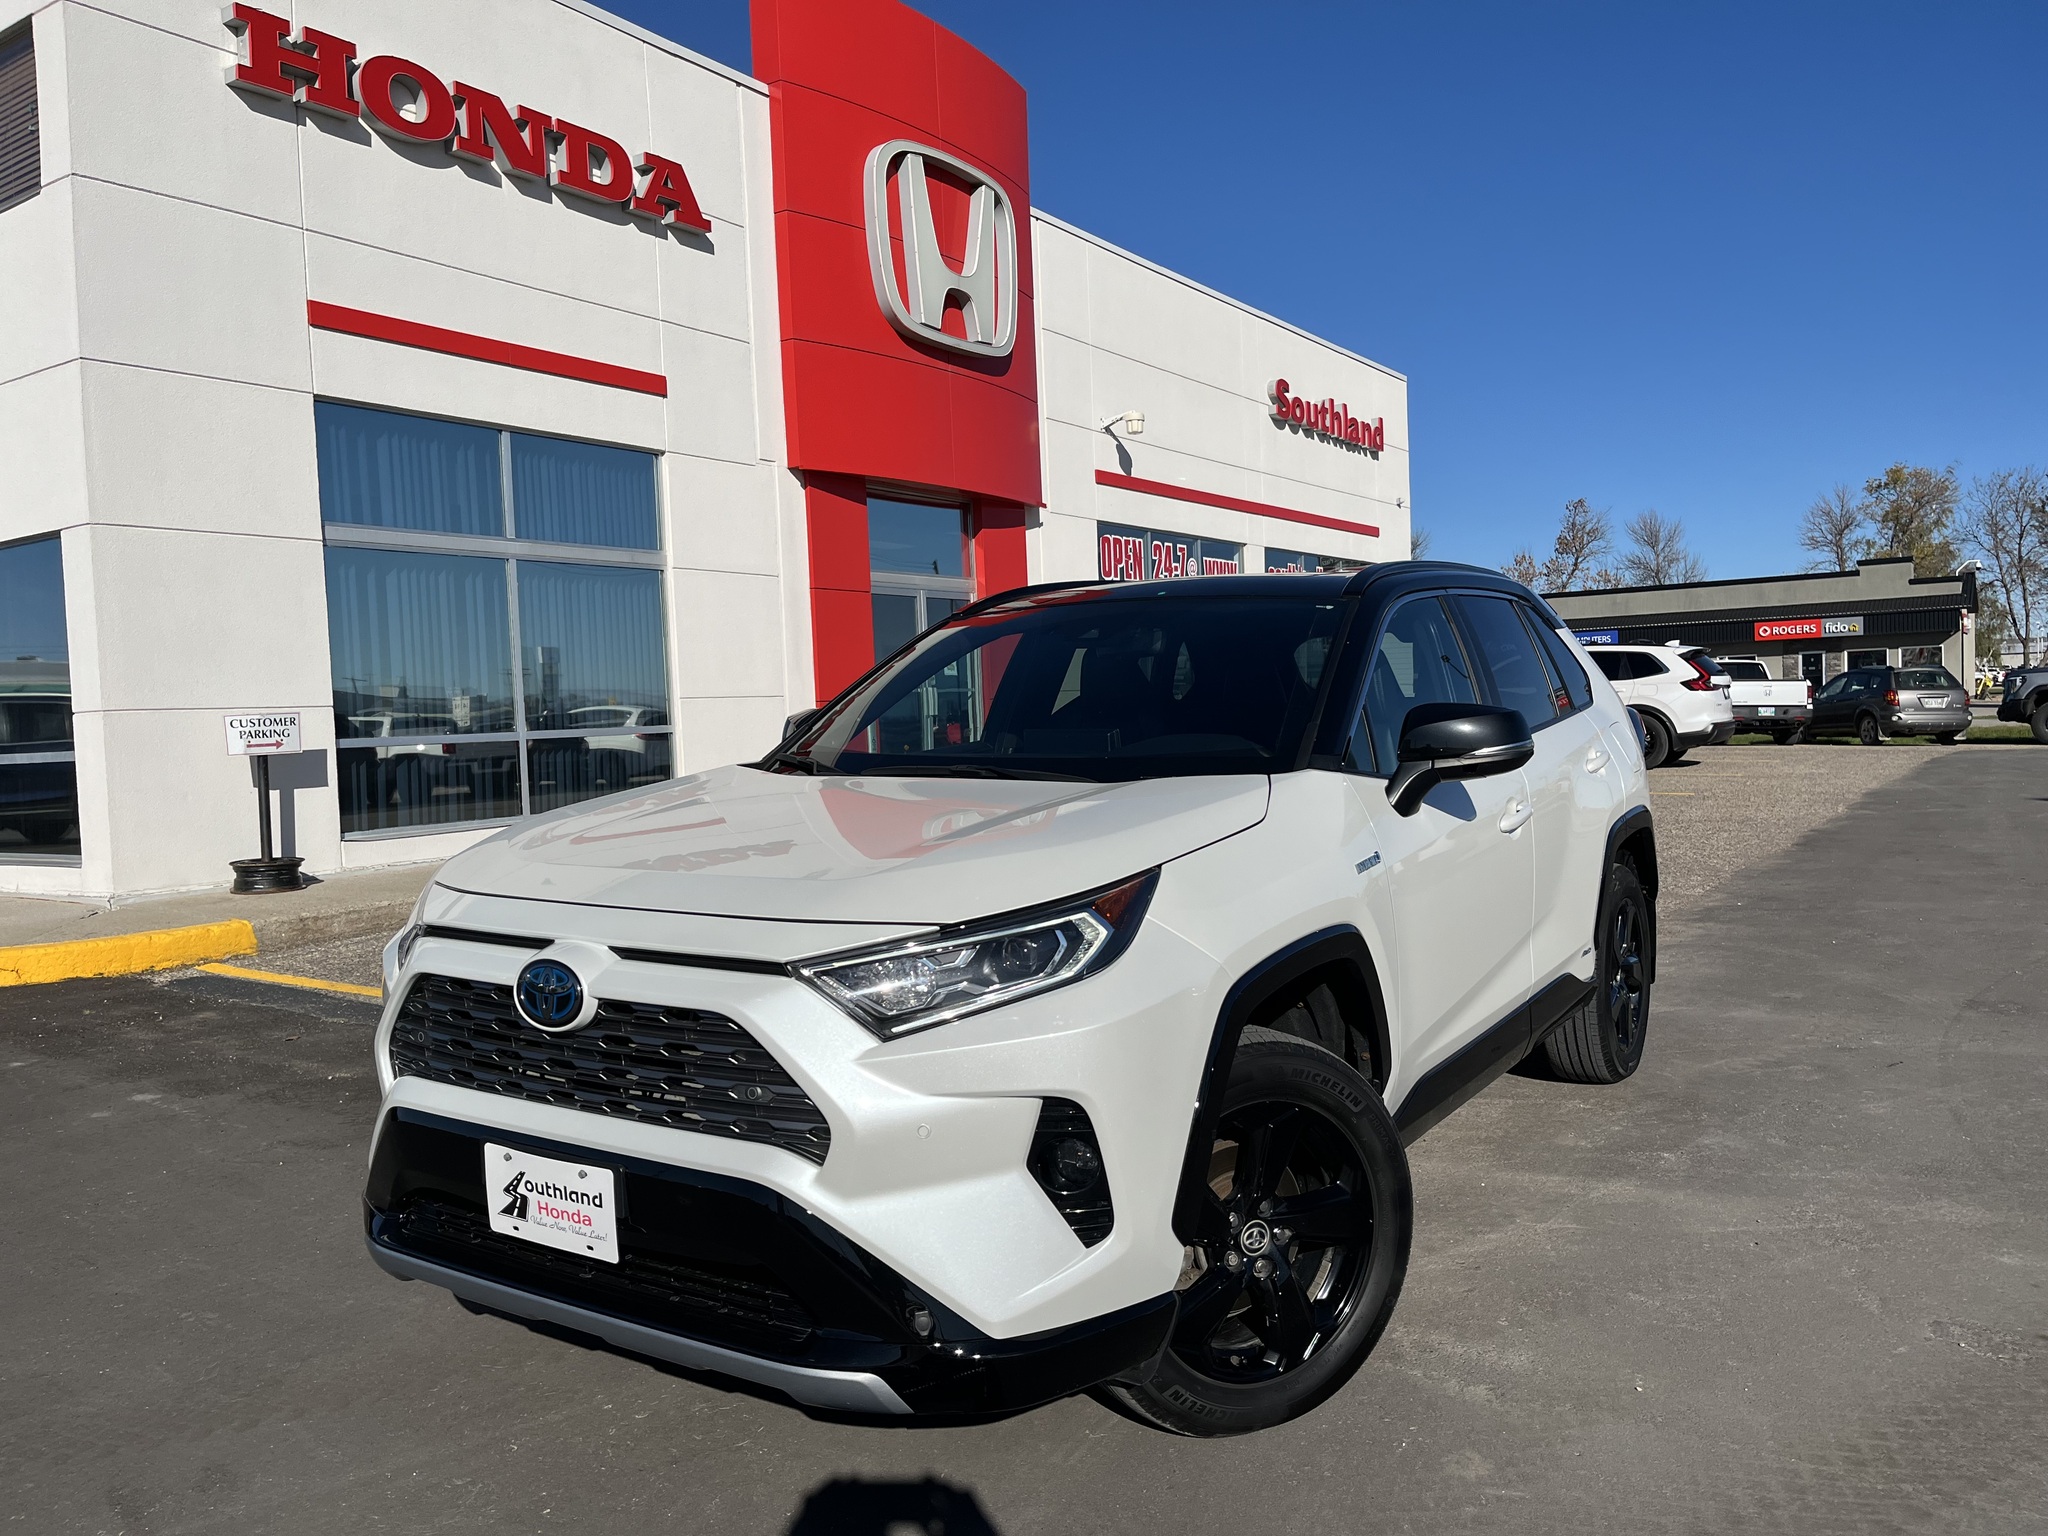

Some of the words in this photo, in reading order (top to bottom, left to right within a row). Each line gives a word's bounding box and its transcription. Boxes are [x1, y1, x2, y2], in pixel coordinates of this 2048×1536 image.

[222, 2, 712, 234] HONDA
[1267, 378, 1384, 452] Southland
[1100, 535, 1144, 581] OPEN
[1152, 540, 1187, 579] 24-7
[1772, 623, 1817, 636] ROGERS
[1825, 622, 1849, 633] fido
[229, 717, 296, 729] CUSTOMER
[239, 728, 290, 740] PARKING
[1290, 1067, 1363, 1109] MICHELIN
[530, 1214, 548, 1228] Value
[568, 1224, 588, 1238] Value
[537, 1200, 592, 1227] Honda
